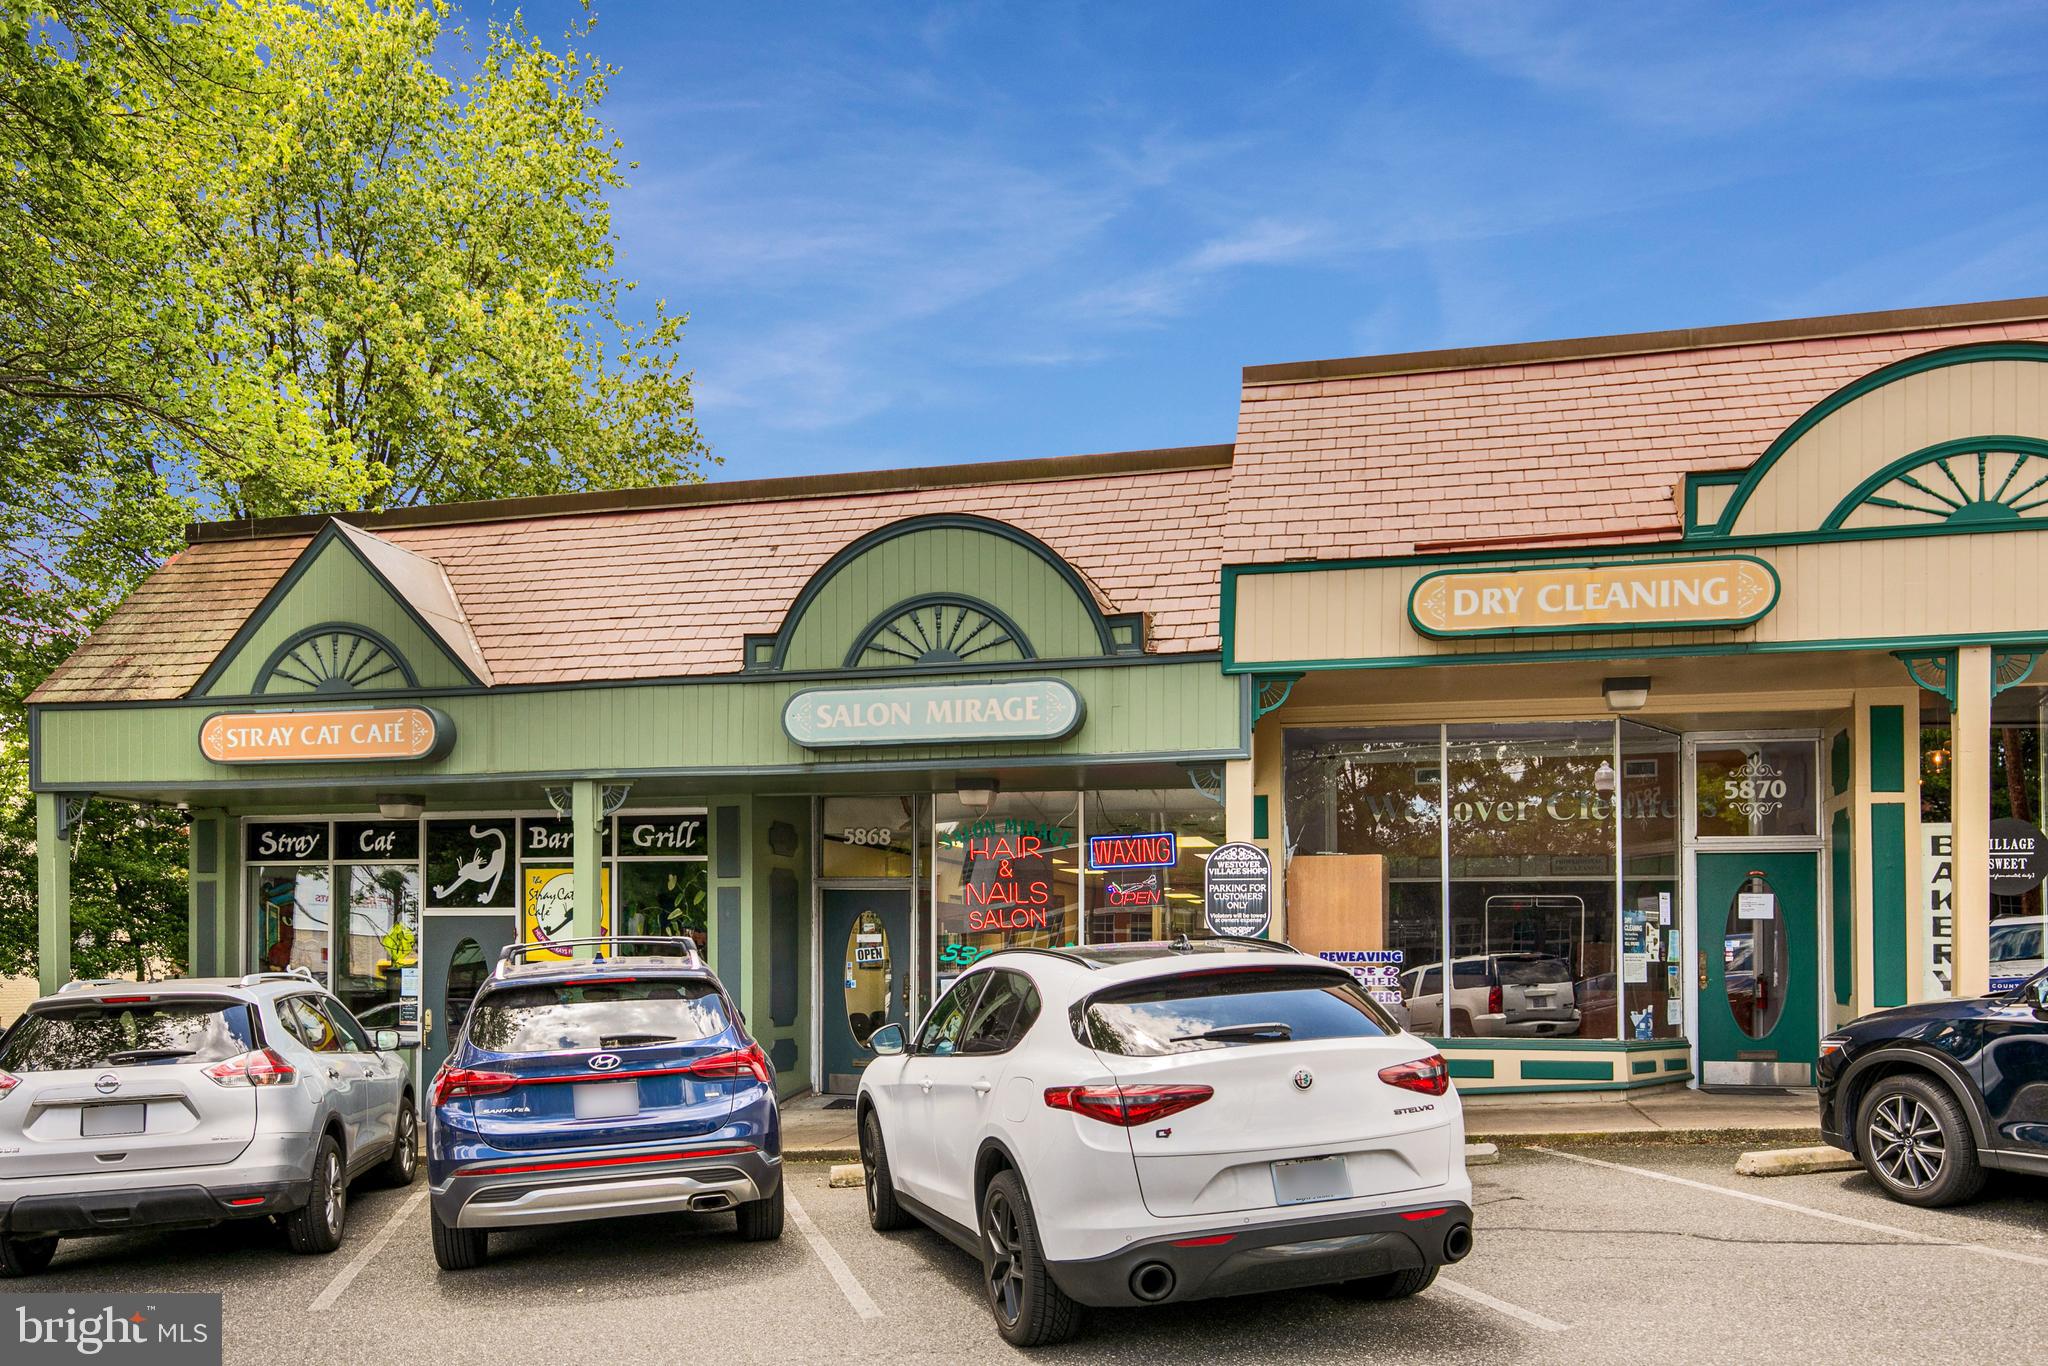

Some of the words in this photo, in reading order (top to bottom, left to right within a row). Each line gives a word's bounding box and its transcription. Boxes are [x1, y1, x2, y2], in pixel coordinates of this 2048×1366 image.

[1453, 587, 1524, 616] DRY
[1537, 577, 1729, 612] CLEANING
[816, 702, 911, 729] SALON
[926, 696, 1040, 724] MIRAGE
[226, 726, 295, 748] STRAY
[300, 725, 343, 745] CAT
[350, 717, 405, 744] CAFÉ
[1725, 778, 1787, 800] 5870
[1546, 791, 1718, 821] Cleanes
[259, 831, 320, 858] Stray
[359, 829, 396, 851] Cat
[529, 826, 573, 849] Bar
[632, 821, 700, 849] Grill
[843, 828, 891, 845] 5868
[1005, 817, 1073, 849] MIRAGE
[970, 836, 1043, 861] HAIR
[1094, 837, 1171, 864] WAXING
[1989, 837, 2035, 850] ILLAGE
[999, 859, 1014, 878] &
[1242, 867, 1268, 875] SHOPS
[1989, 858, 2028, 870] SWEET
[532, 876, 542, 884] The
[1209, 884, 1247, 893] PARKING
[1249, 884, 1267, 892] FOR
[528, 887, 556, 905] Stray
[557, 887, 574, 900] Cat
[966, 881, 1048, 905] NAILS
[1109, 889, 1161, 906] OPEN
[528, 904, 552, 921] Café
[1226, 902, 1248, 910] ONLY
[970, 907, 1047, 930] SALON
[857, 947, 883, 961] OPEN
[1320, 952, 1402, 962] REWEAVING
[1383, 967, 1398, 976] &
[1393, 1104, 1435, 1116] STELVIO
